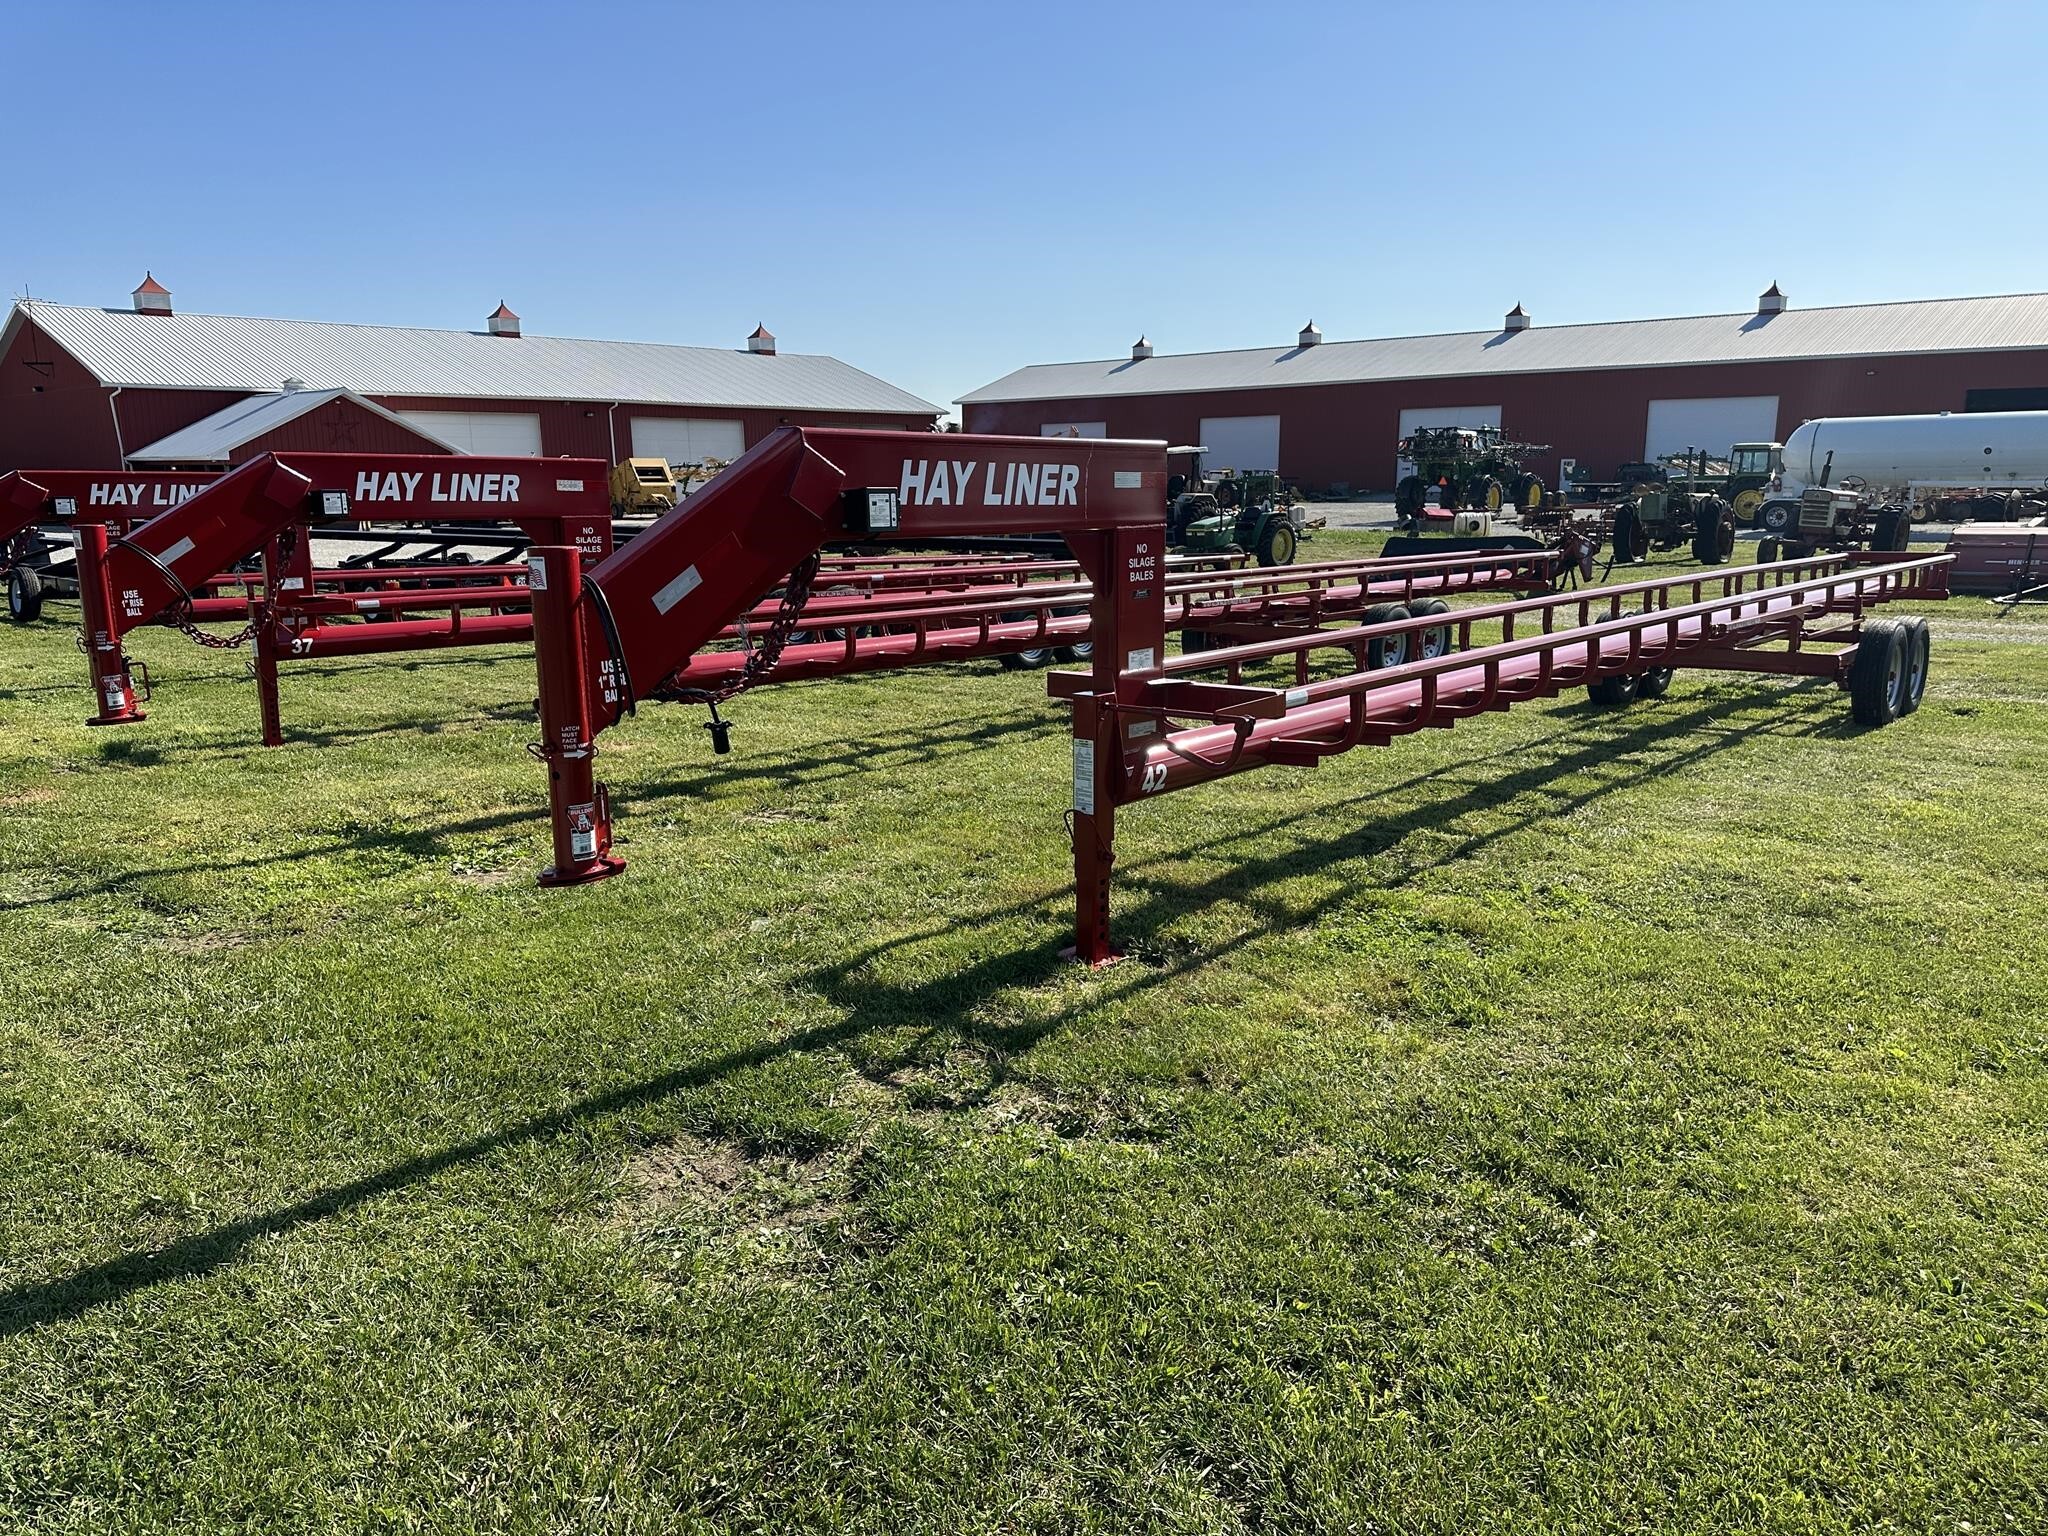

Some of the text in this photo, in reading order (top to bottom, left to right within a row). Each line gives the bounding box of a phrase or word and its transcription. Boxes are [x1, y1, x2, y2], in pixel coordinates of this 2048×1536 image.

[355, 472, 520, 502] HAY LINER
[900, 459, 1080, 505] HAY LINER
[89, 483, 209, 505] HAY LIN
[582, 527, 594, 535] NO
[575, 536, 602, 544] SILAGE
[577, 545, 602, 553] BALES
[1136, 543, 1148, 554] NO
[1128, 556, 1155, 568] SILAGE
[1130, 570, 1154, 582] BALES
[122, 589, 139, 599] USE
[121, 598, 144, 608] 1" RISE
[126, 608, 143, 617] BALL
[291, 638, 313, 653] 37
[598, 675, 608, 689] 1"
[1141, 763, 1168, 793] 42
